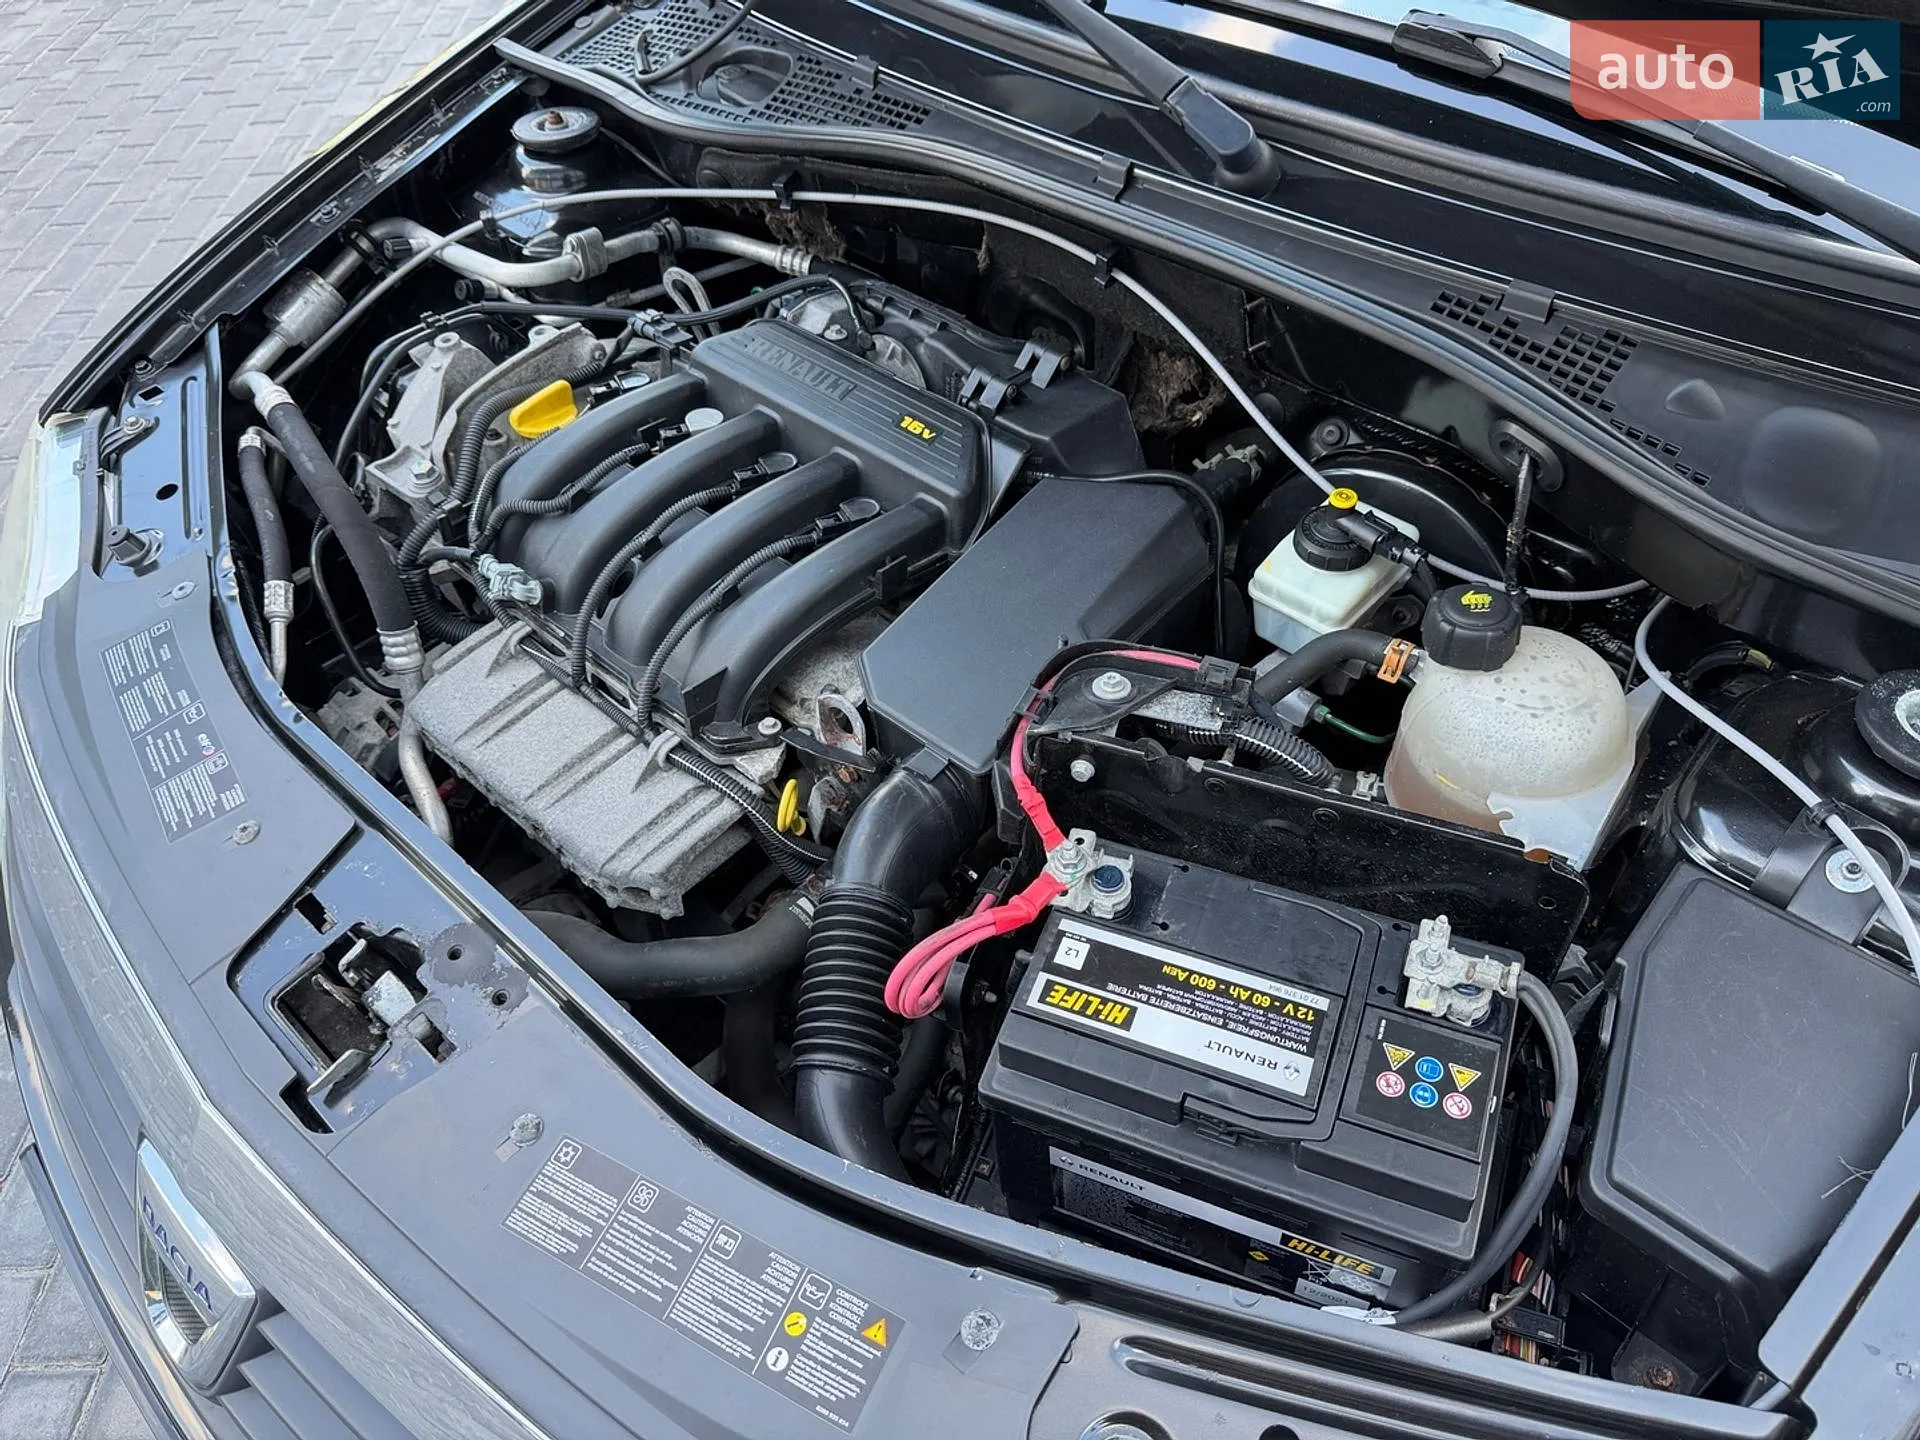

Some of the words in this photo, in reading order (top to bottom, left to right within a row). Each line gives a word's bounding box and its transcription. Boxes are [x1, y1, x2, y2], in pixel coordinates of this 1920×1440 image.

[746, 338, 857, 401] RENAULT
[899, 415, 937, 441] 16v
[1064, 946, 1079, 958] L2
[1105, 981, 1148, 1002] BATTERIE
[1188, 972, 1217, 991] 600
[1045, 982, 1130, 1026] Hi-LIFE
[1148, 995, 1223, 1026] EINSATZBEREITE
[1203, 1038, 1279, 1071] RENAULT
[1077, 1162, 1146, 1192] RENAULT
[142, 1195, 213, 1312] DACIA
[1288, 1237, 1376, 1275] Hi-LIFE
